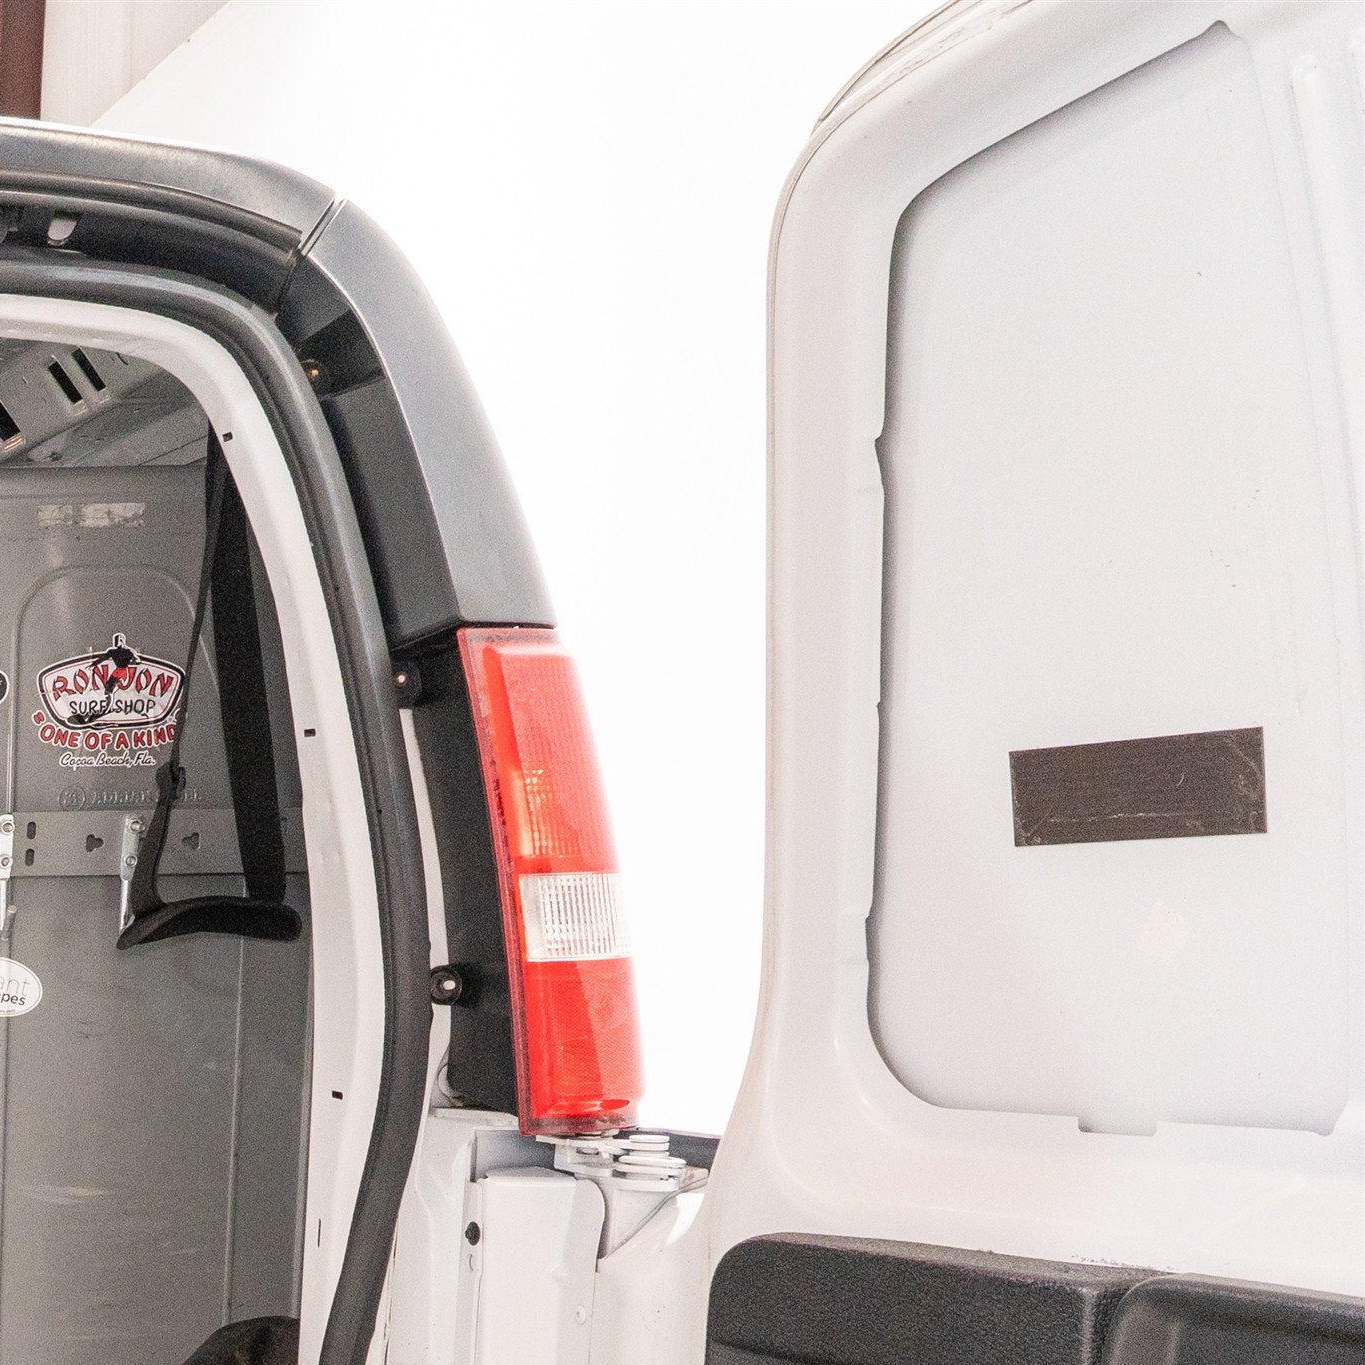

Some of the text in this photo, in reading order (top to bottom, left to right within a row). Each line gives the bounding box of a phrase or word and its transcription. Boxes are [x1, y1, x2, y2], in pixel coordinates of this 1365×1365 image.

[52, 664, 175, 701] RON JON
[69, 699, 156, 716] SURF SHOP
[85, 732, 112, 750] OF
[115, 732, 129, 749] A
[60, 752, 95, 766] Cocoa
[135, 752, 157, 766] Fla.
